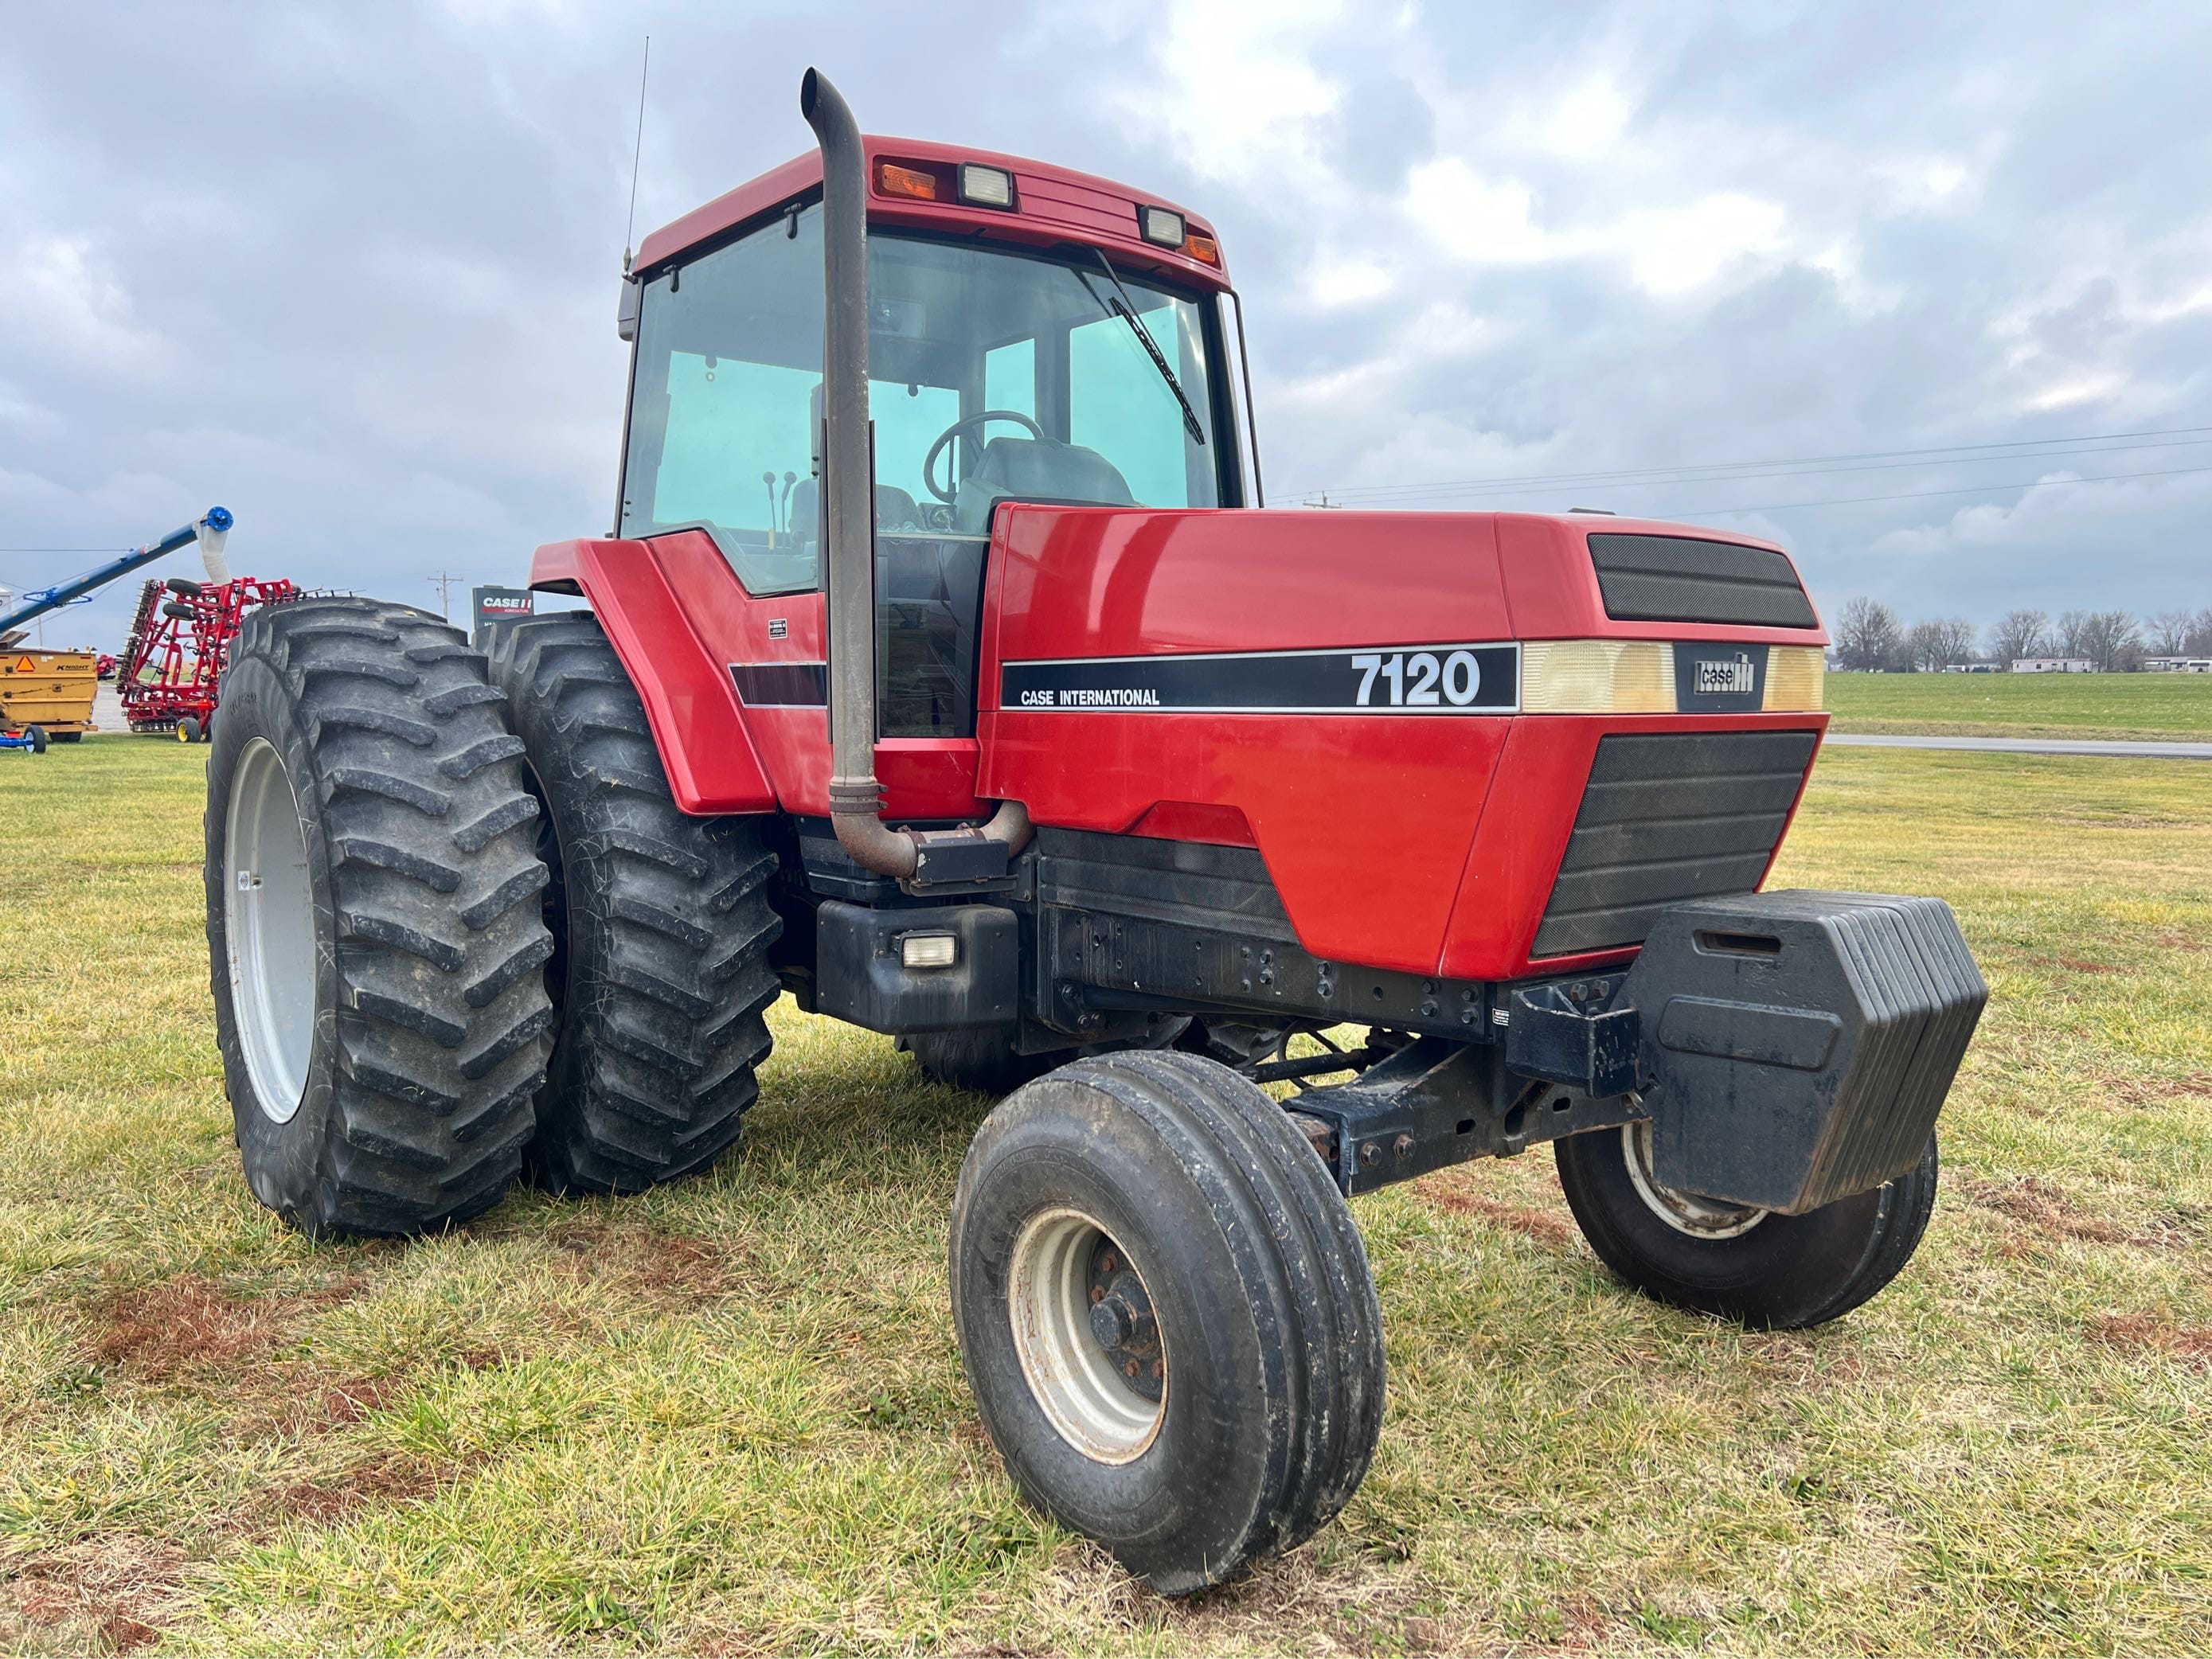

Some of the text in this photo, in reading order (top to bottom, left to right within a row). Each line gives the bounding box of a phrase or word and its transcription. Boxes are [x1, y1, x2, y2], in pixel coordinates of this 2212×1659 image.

[483, 597, 520, 608] CASE
[1351, 650, 1481, 706] 7120
[1021, 689, 1160, 705] CASE INTERNATIONAL
